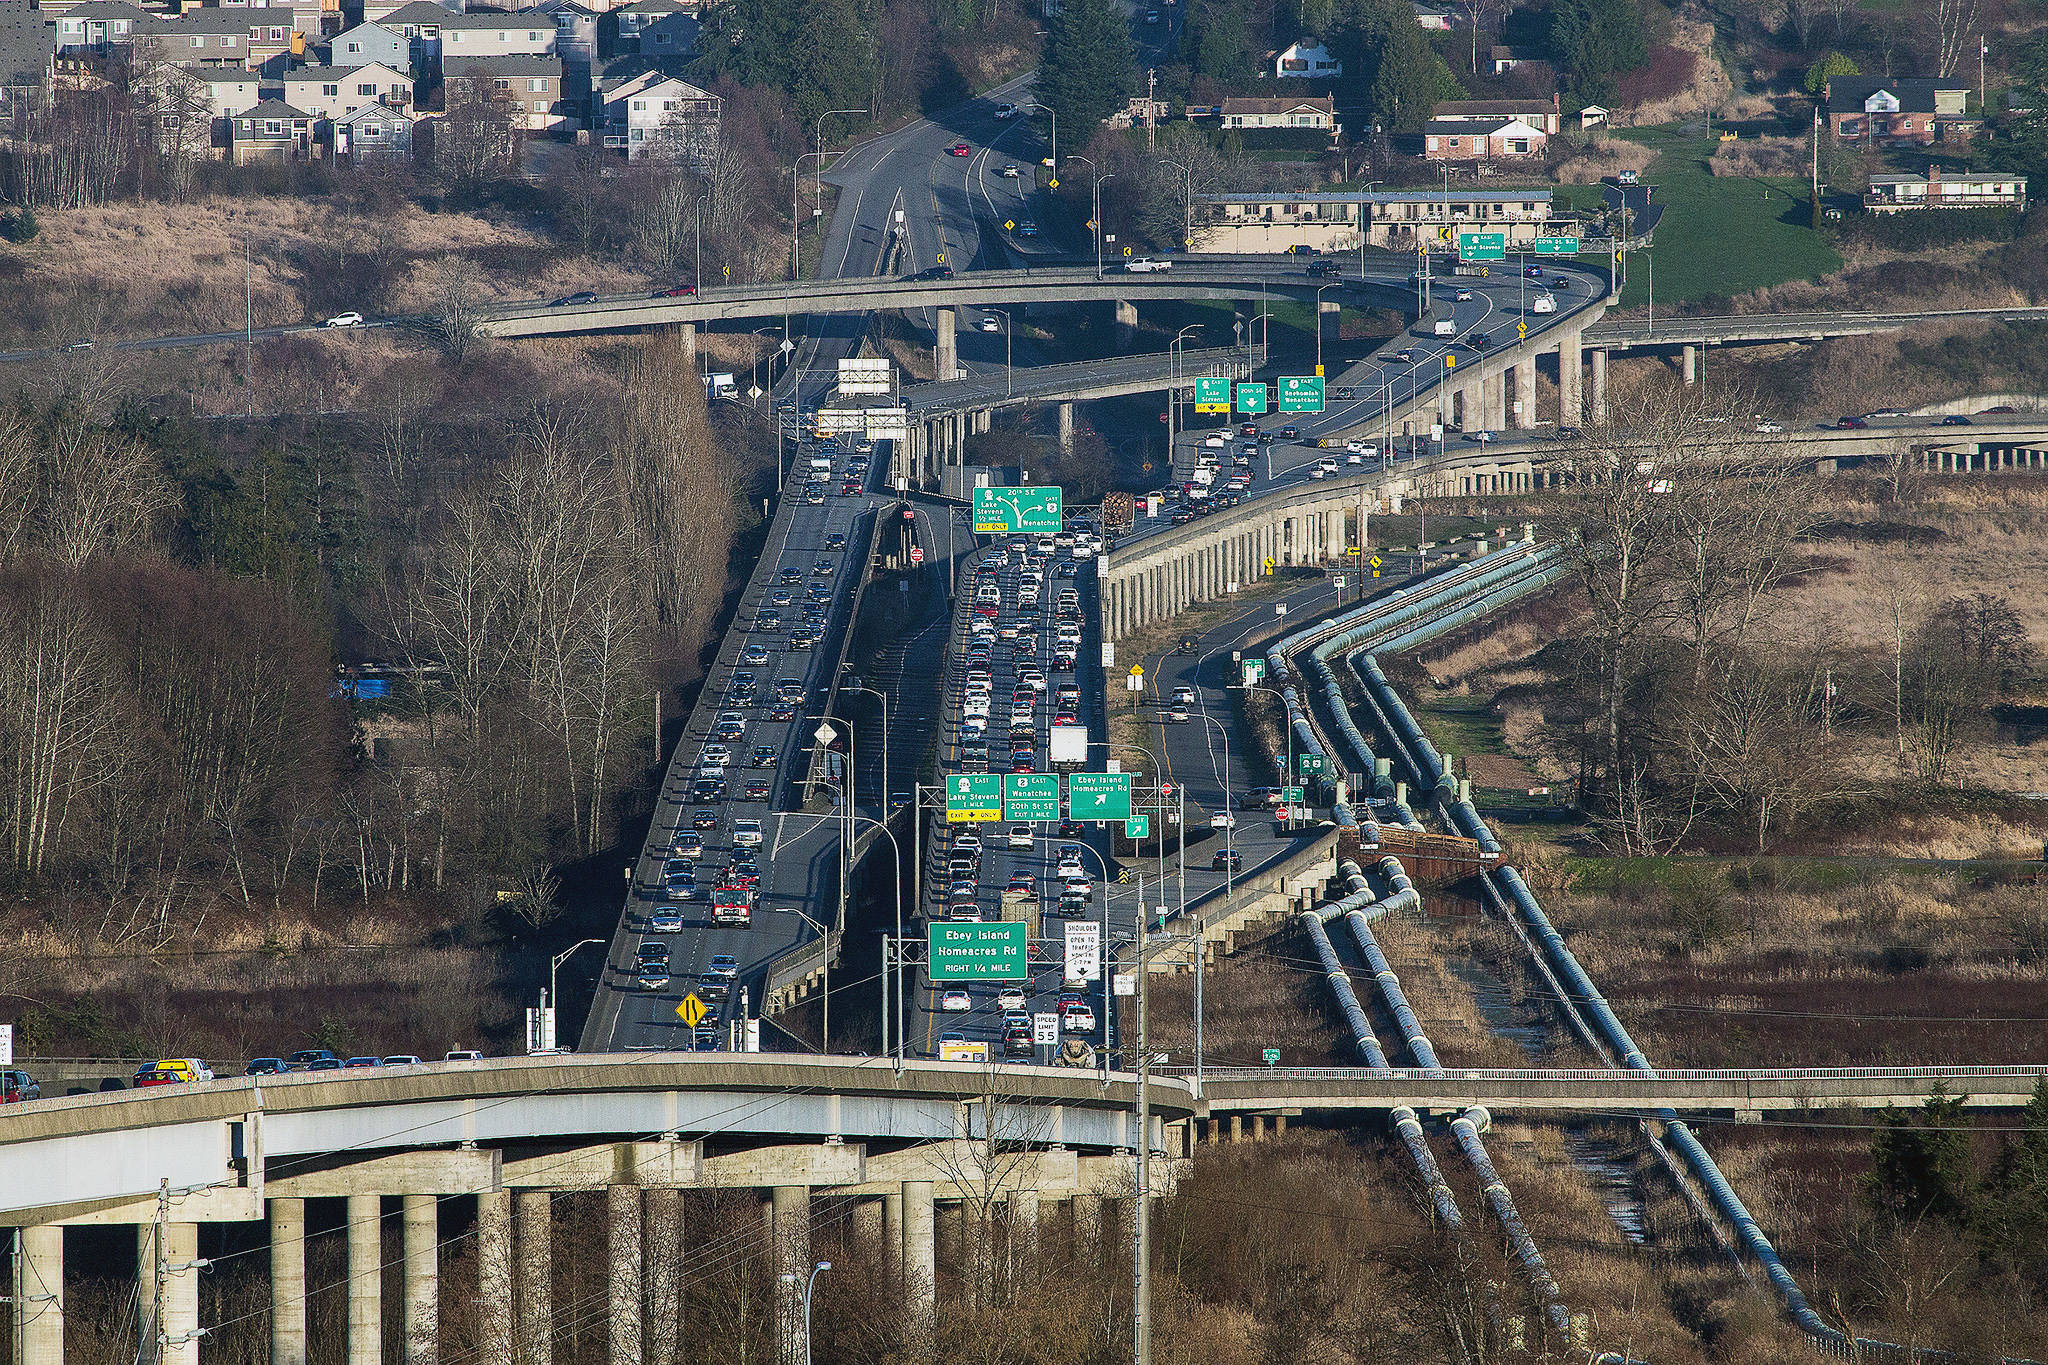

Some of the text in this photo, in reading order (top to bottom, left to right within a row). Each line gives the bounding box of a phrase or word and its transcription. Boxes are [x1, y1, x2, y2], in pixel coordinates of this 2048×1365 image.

[1022, 519, 1060, 527] Wenatchee
[1077, 776, 1123, 786] Ebey Island
[1072, 784, 1128, 793] Homeacres Rd
[948, 792, 1000, 801] Lake Stevens
[1010, 802, 1054, 810] 20th St SE
[1068, 924, 1097, 932] SHOULDER
[945, 930, 1010, 942] Ebey Island
[938, 945, 1017, 956] Homeacres Rd
[945, 964, 970, 972] RIGHT
[990, 963, 1011, 972] MILE
[1037, 1031, 1055, 1041] 55
